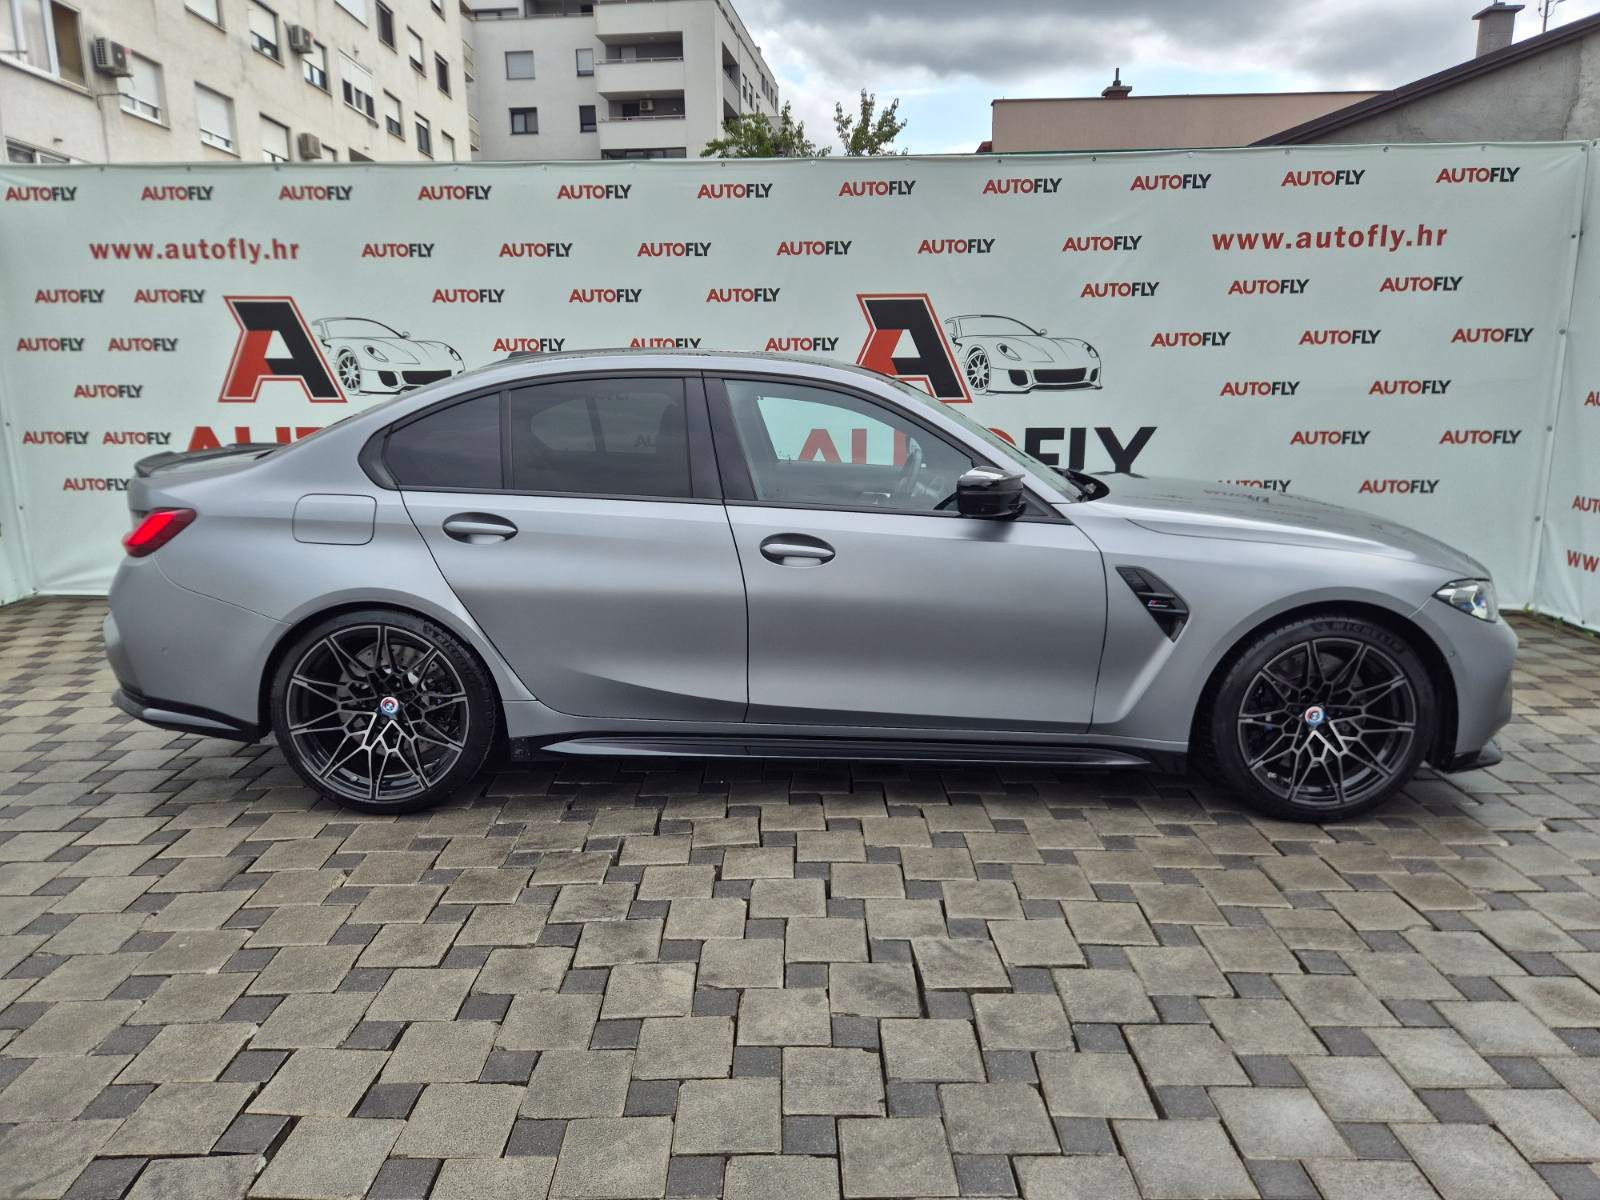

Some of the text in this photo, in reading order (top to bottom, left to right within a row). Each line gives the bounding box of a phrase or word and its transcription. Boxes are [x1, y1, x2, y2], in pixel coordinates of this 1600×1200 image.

[1130, 174, 1212, 191] AUTOFLY
[1281, 169, 1365, 186] AUTOFLY
[1435, 167, 1520, 183] AUTOFLY
[141, 186, 214, 201] AUTOFLY
[279, 185, 353, 201] AUTOFLY
[417, 185, 492, 200] AUTOFLY
[557, 184, 632, 200] AUTOFLY
[697, 183, 773, 199] AUTOFLY
[838, 180, 916, 197] AUTOFLY
[982, 178, 1062, 194] AUTOFLY
[5, 187, 77, 201] AUTOFLY
[1062, 235, 1142, 252] AUTOFLY
[1212, 224, 1447, 252] www.autofly.hr
[89, 237, 299, 265] www.autofly.hr
[362, 243, 435, 258] AUTOFLY
[499, 243, 573, 257] AUTOFLY
[637, 242, 711, 257] AUTOFLY
[776, 241, 852, 256] AUTOFLY
[917, 239, 996, 254] AUTOFLY
[1080, 282, 1160, 298] AUTOFLY
[1228, 279, 1310, 295] AUTOFLY
[1379, 276, 1464, 292] AUTOFLY
[35, 289, 105, 304] AUTOFLY
[134, 289, 206, 303] AUTOFLY
[432, 289, 505, 303] AUTOFLY
[568, 288, 642, 303] AUTOFLY
[706, 288, 780, 302] AUTOFLY
[1150, 332, 1231, 347] AUTOFLY
[1298, 329, 1381, 345] AUTOFLY
[1451, 328, 1534, 343] AUTOFLY
[16, 337, 85, 352] AUTOFLY
[108, 338, 179, 352] AUTOFLY
[493, 337, 565, 352] AUTOFLY
[765, 337, 839, 352] AUTOFLY
[74, 384, 144, 398] AUTOFLY
[1220, 381, 1300, 396] AUTOFLY
[1368, 380, 1452, 395] AUTOFLY
[22, 431, 90, 445] AUTOFLY
[102, 432, 171, 445] AUTOFLY
[1290, 430, 1371, 445] AUTOFLY
[1439, 430, 1522, 444] AUTOFLY
[63, 478, 130, 491] AUTOFLY
[1358, 479, 1440, 494] AUTOFLY
